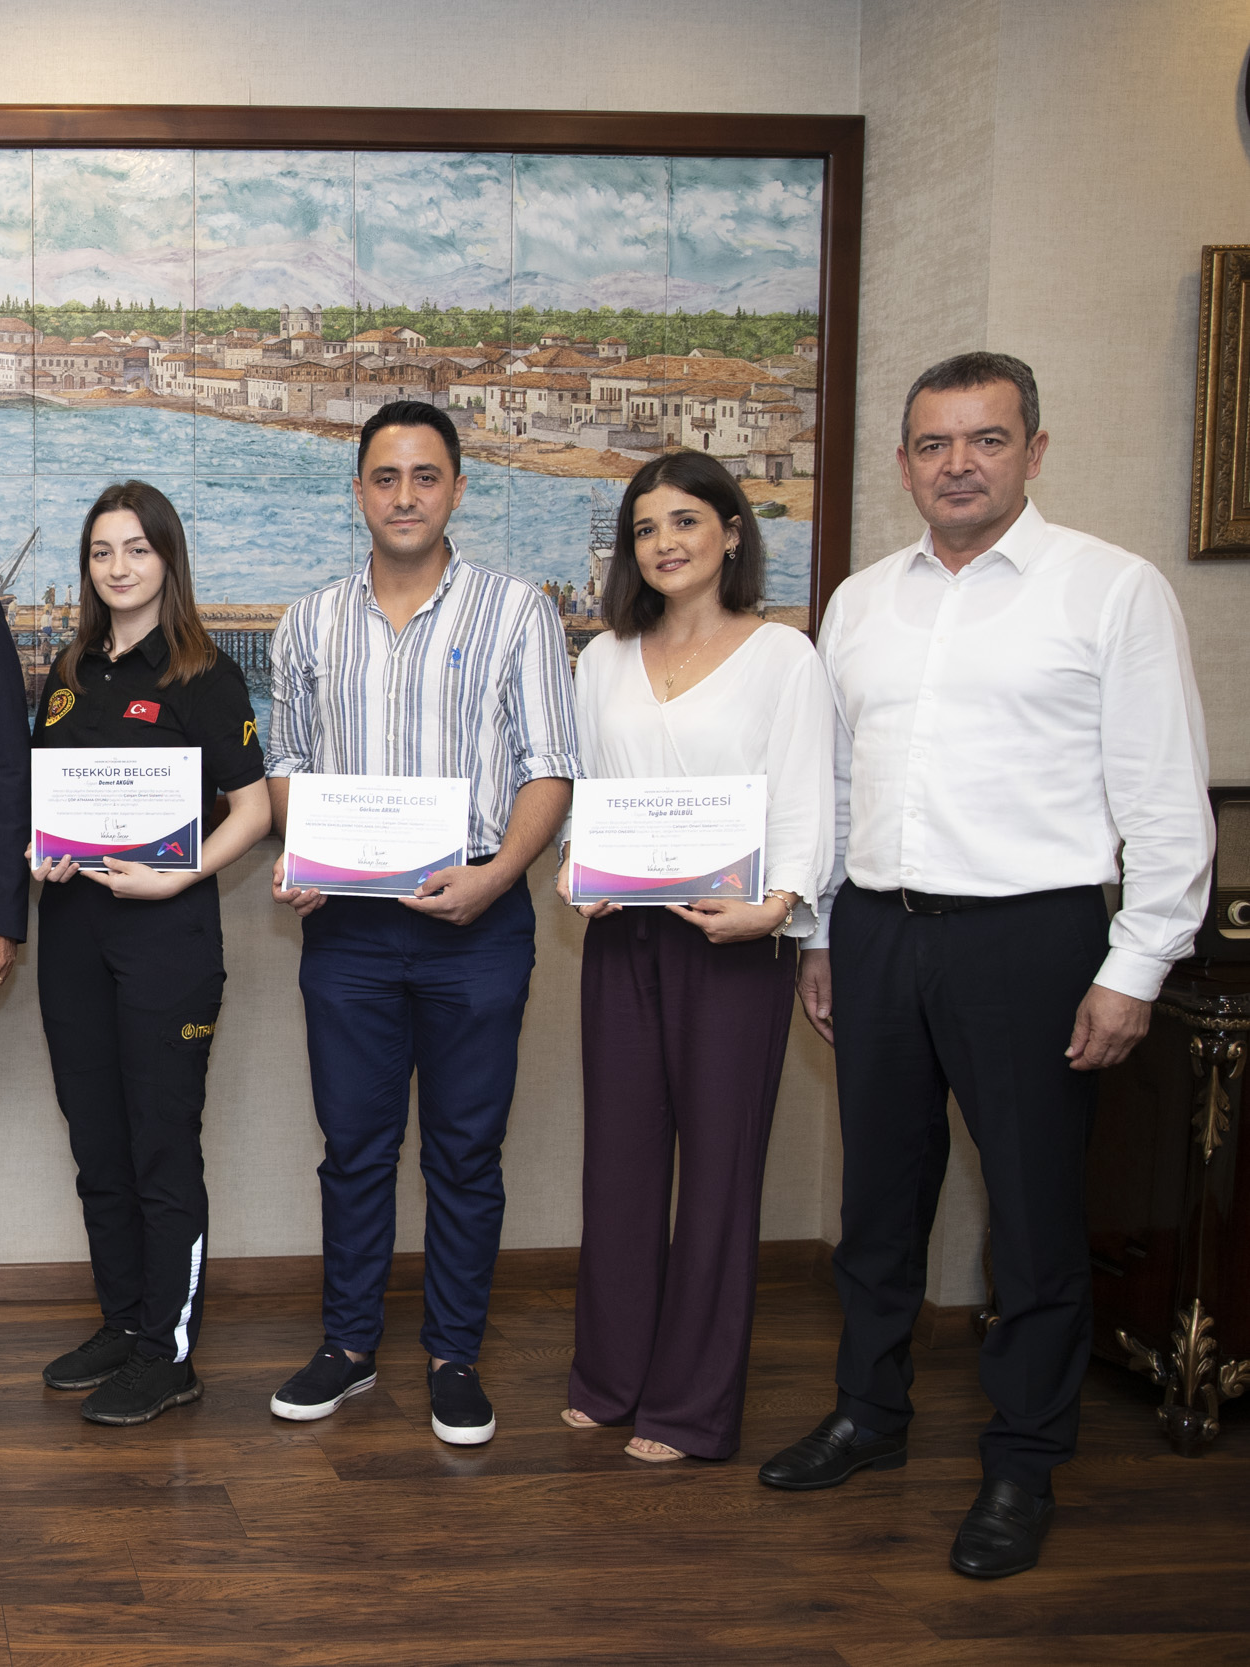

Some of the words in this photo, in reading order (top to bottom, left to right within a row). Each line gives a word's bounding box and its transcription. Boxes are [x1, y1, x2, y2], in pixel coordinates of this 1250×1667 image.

[62, 766, 121, 779] TEŞEKKÜR
[124, 766, 171, 777] BELGESİ
[116, 778, 134, 786] AKGÜN
[321, 793, 383, 805] TEŞEKKÜR
[387, 795, 437, 806] BELGESİ
[607, 796, 673, 810] TEŞEKKÜR
[677, 794, 731, 807] BELGESİ
[648, 809, 668, 818] Tuğba
[669, 808, 693, 816] BÜLBÜL
